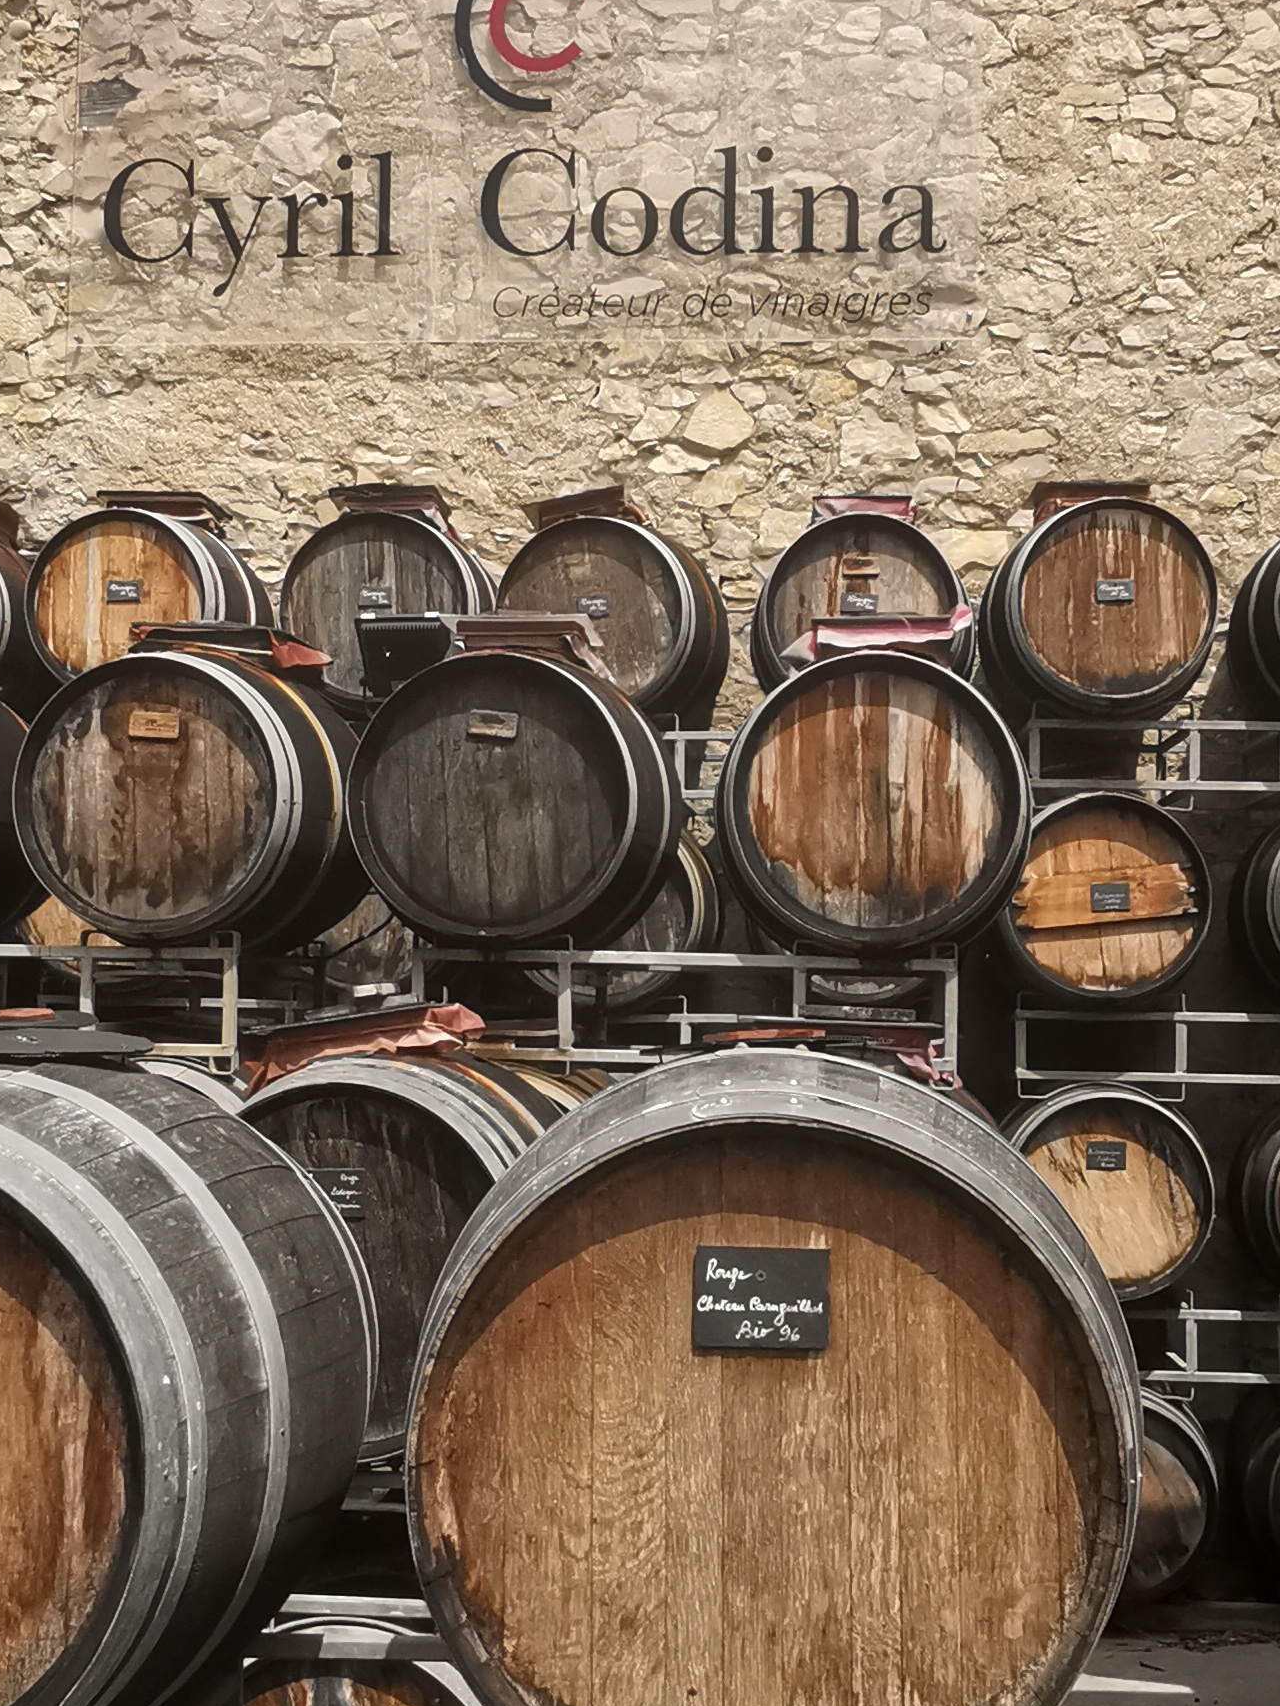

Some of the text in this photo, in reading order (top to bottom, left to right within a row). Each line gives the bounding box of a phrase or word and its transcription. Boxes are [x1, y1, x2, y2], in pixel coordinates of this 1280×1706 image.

[103, 145, 948, 297] Cyril Codina
[491, 285, 932, 323] Créateur de vinaigres
[706, 1258, 753, 1290] Rouge
[735, 1320, 800, 1341] Bio 96
